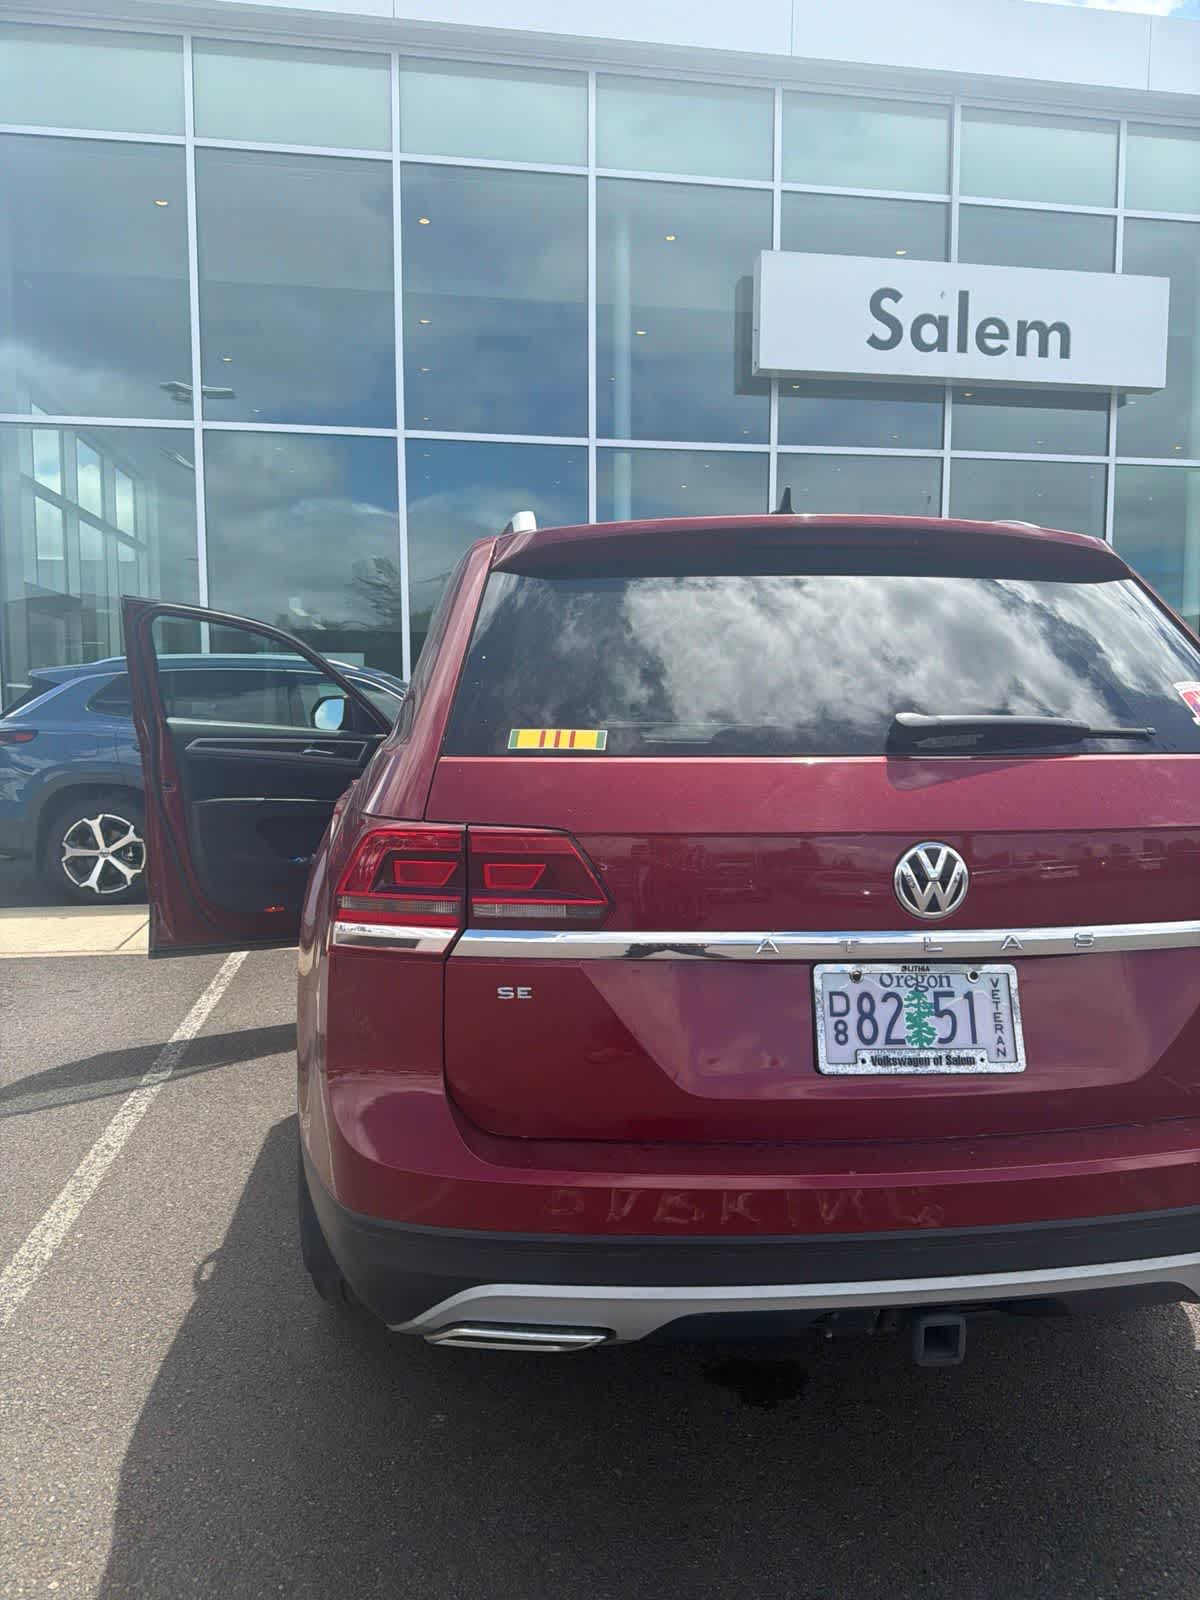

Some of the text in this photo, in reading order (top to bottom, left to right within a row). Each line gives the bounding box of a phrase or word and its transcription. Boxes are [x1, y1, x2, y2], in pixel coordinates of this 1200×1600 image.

[866, 286, 1072, 360] Salem
[755, 931, 1095, 955] ATLAS
[497, 986, 532, 999] SE
[879, 973, 951, 992] Oregon
[990, 978, 1007, 1057] VETERAN
[870, 1055, 975, 1067] Volkswagen of Salem
